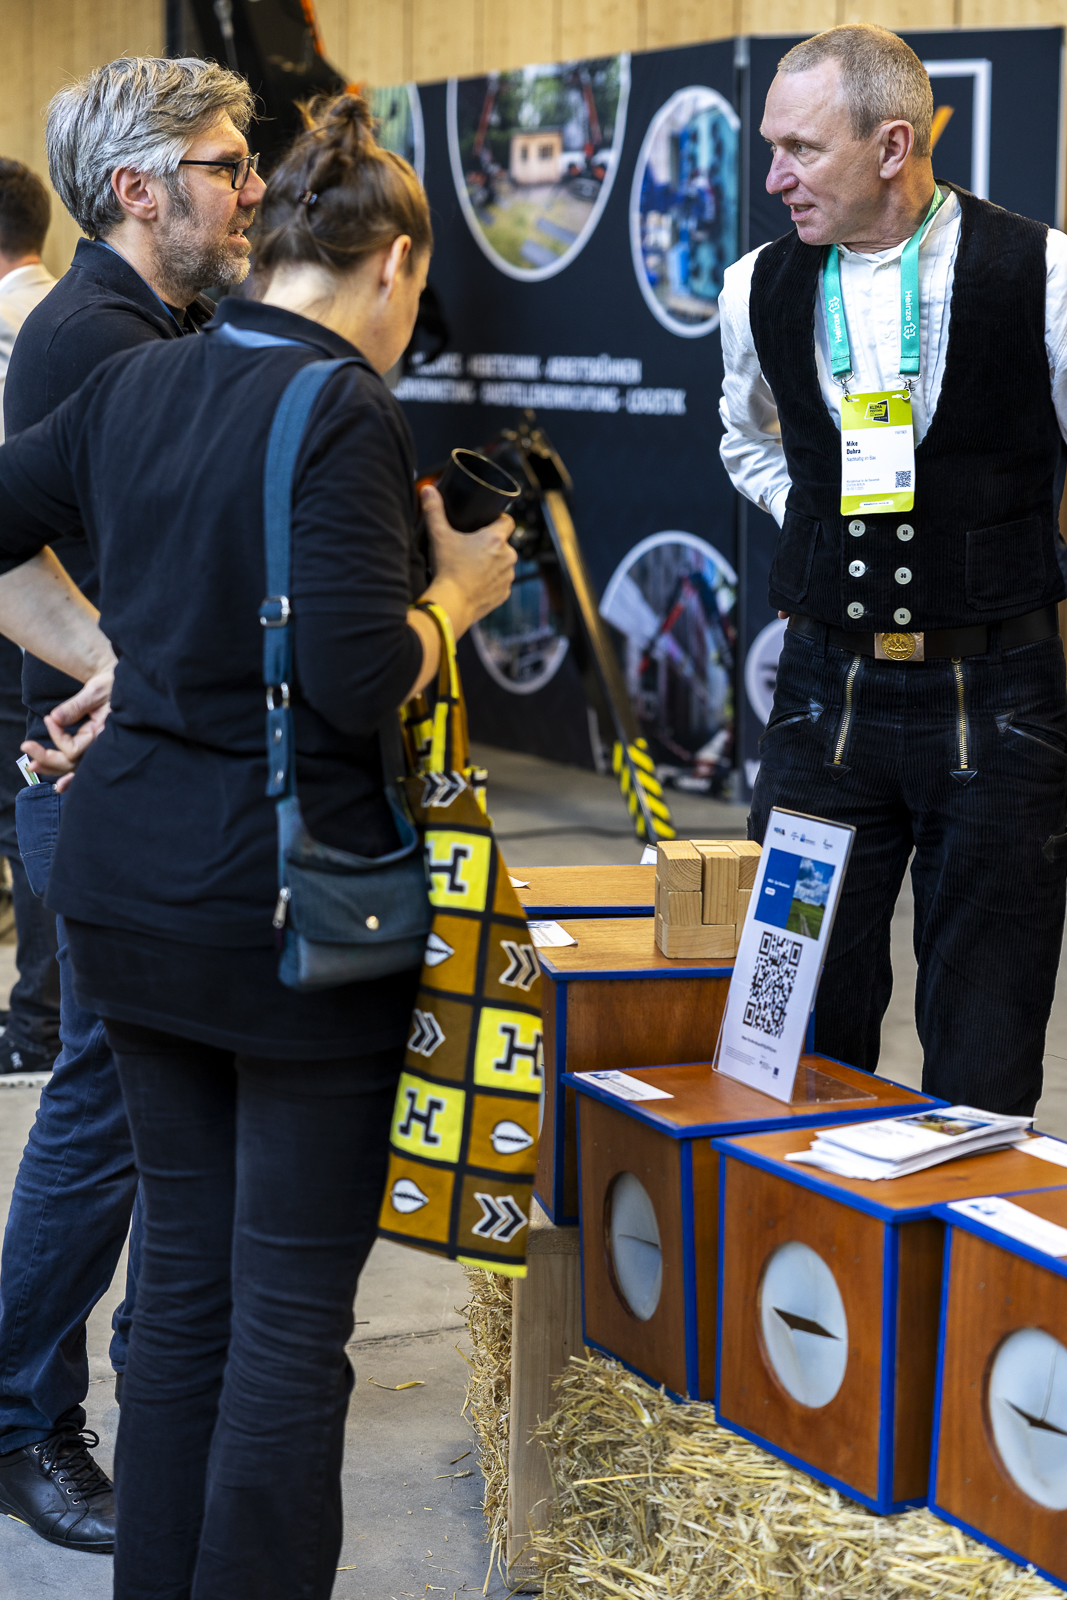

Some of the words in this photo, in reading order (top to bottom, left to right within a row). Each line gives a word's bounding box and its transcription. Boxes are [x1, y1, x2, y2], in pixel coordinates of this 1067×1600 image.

[904, 290, 914, 322] Heinze
[833, 313, 843, 343] Heinze
[626, 388, 687, 416] LOGISTIK
